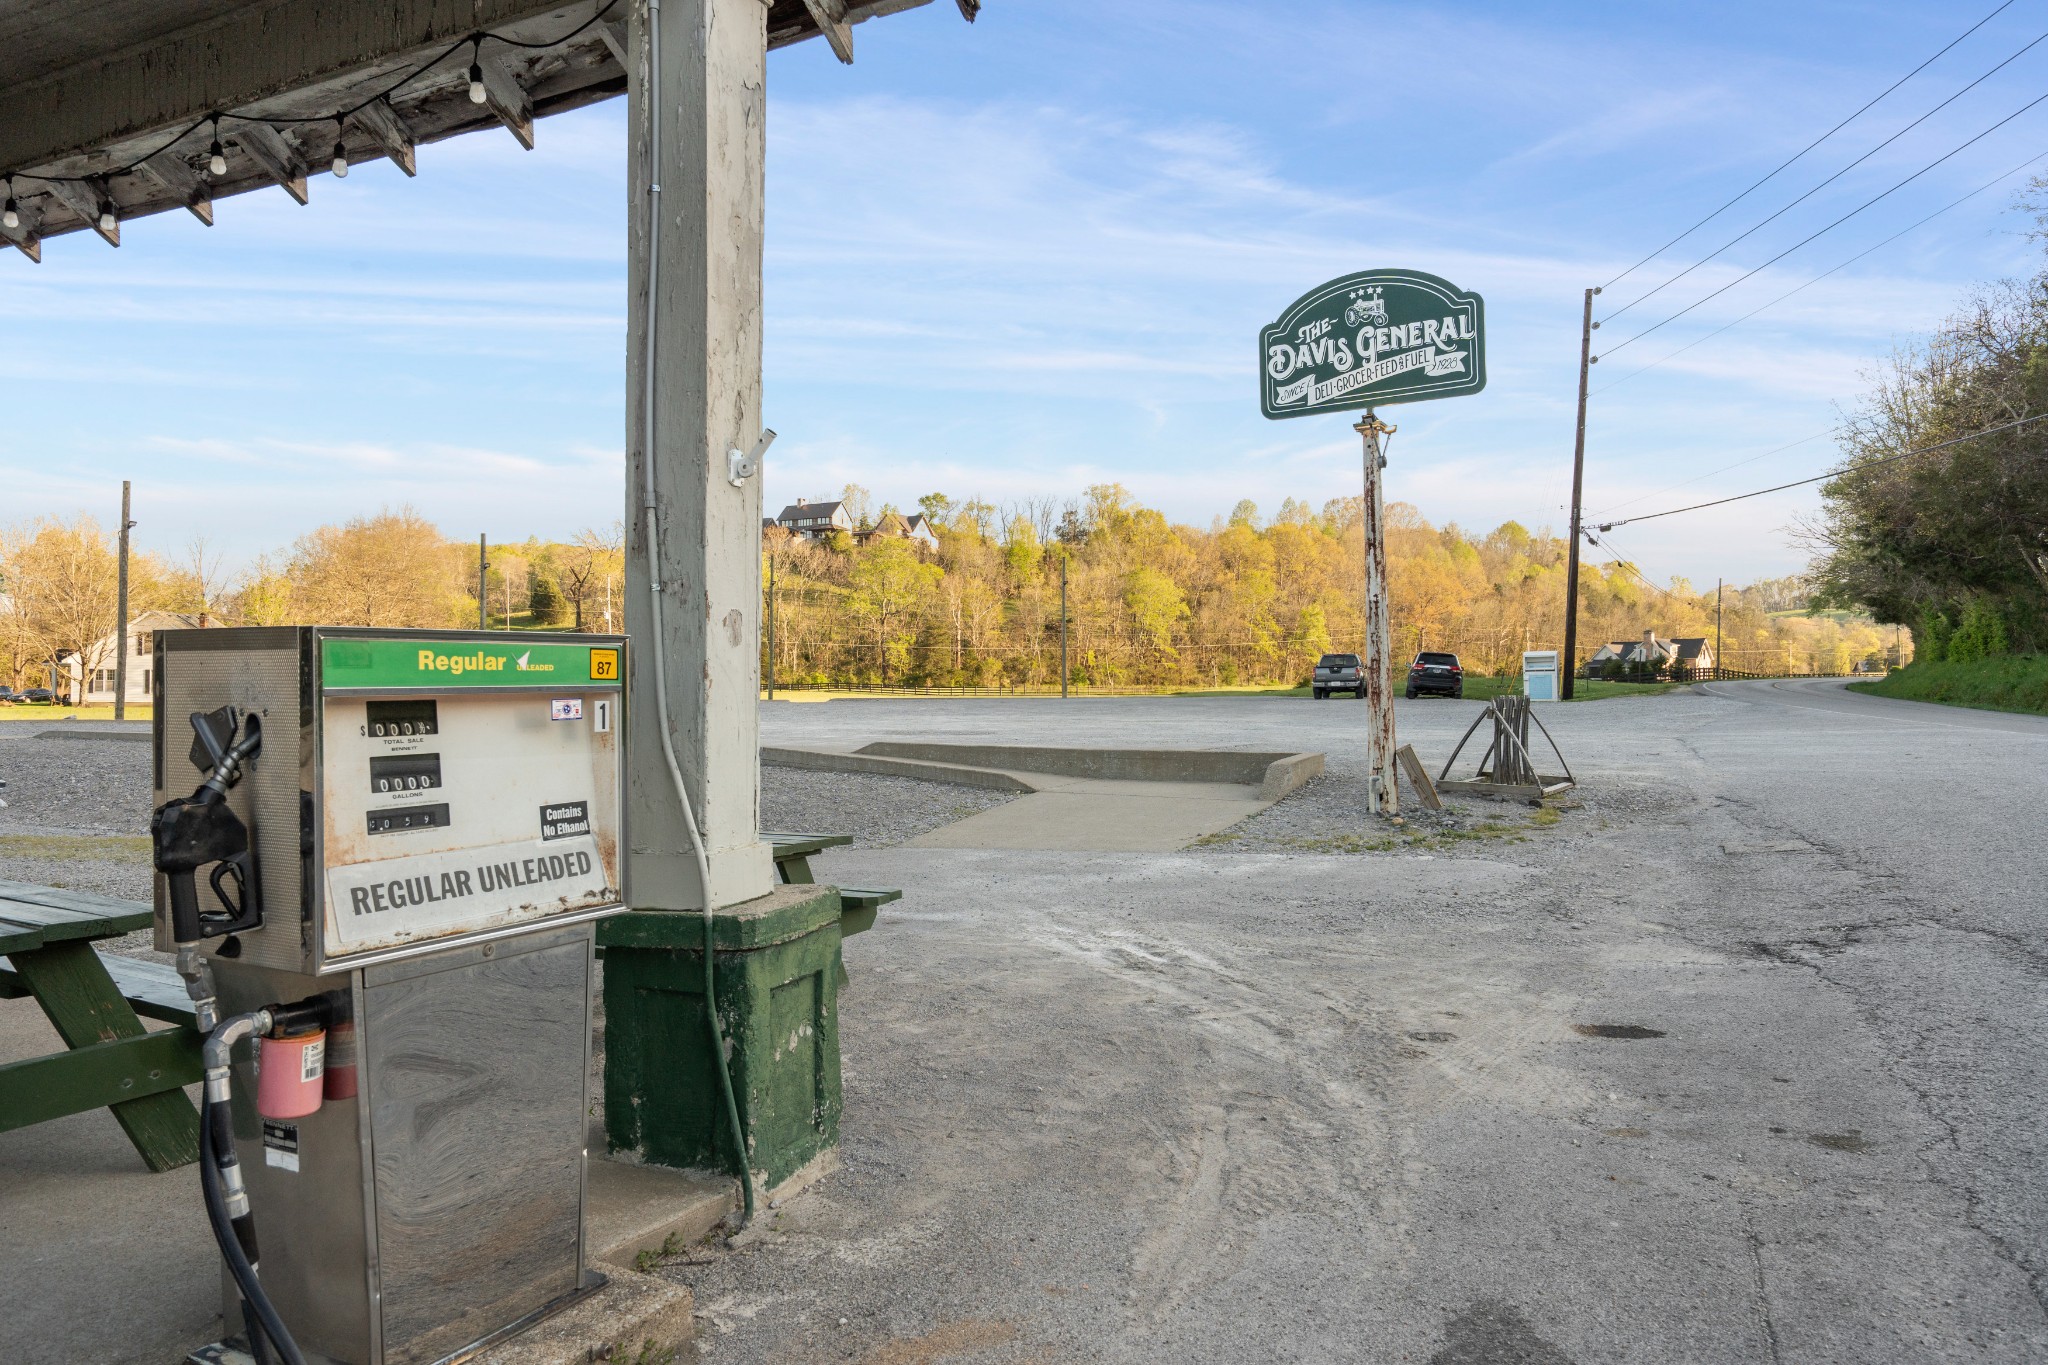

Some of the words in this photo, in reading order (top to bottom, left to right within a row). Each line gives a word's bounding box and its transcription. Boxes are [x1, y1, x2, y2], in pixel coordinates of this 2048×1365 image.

[1297, 318, 1332, 343] THE
[1268, 337, 1354, 380] DAVIS
[1356, 314, 1476, 367] GENERAL
[418, 650, 507, 675] Regular
[597, 661, 612, 675] 87
[599, 702, 606, 730] 1
[546, 806, 582, 821] Contains
[543, 824, 556, 837] No
[556, 820, 589, 835] Ethanol
[350, 870, 474, 916] REGULAR
[477, 851, 592, 893] UNLEADED
